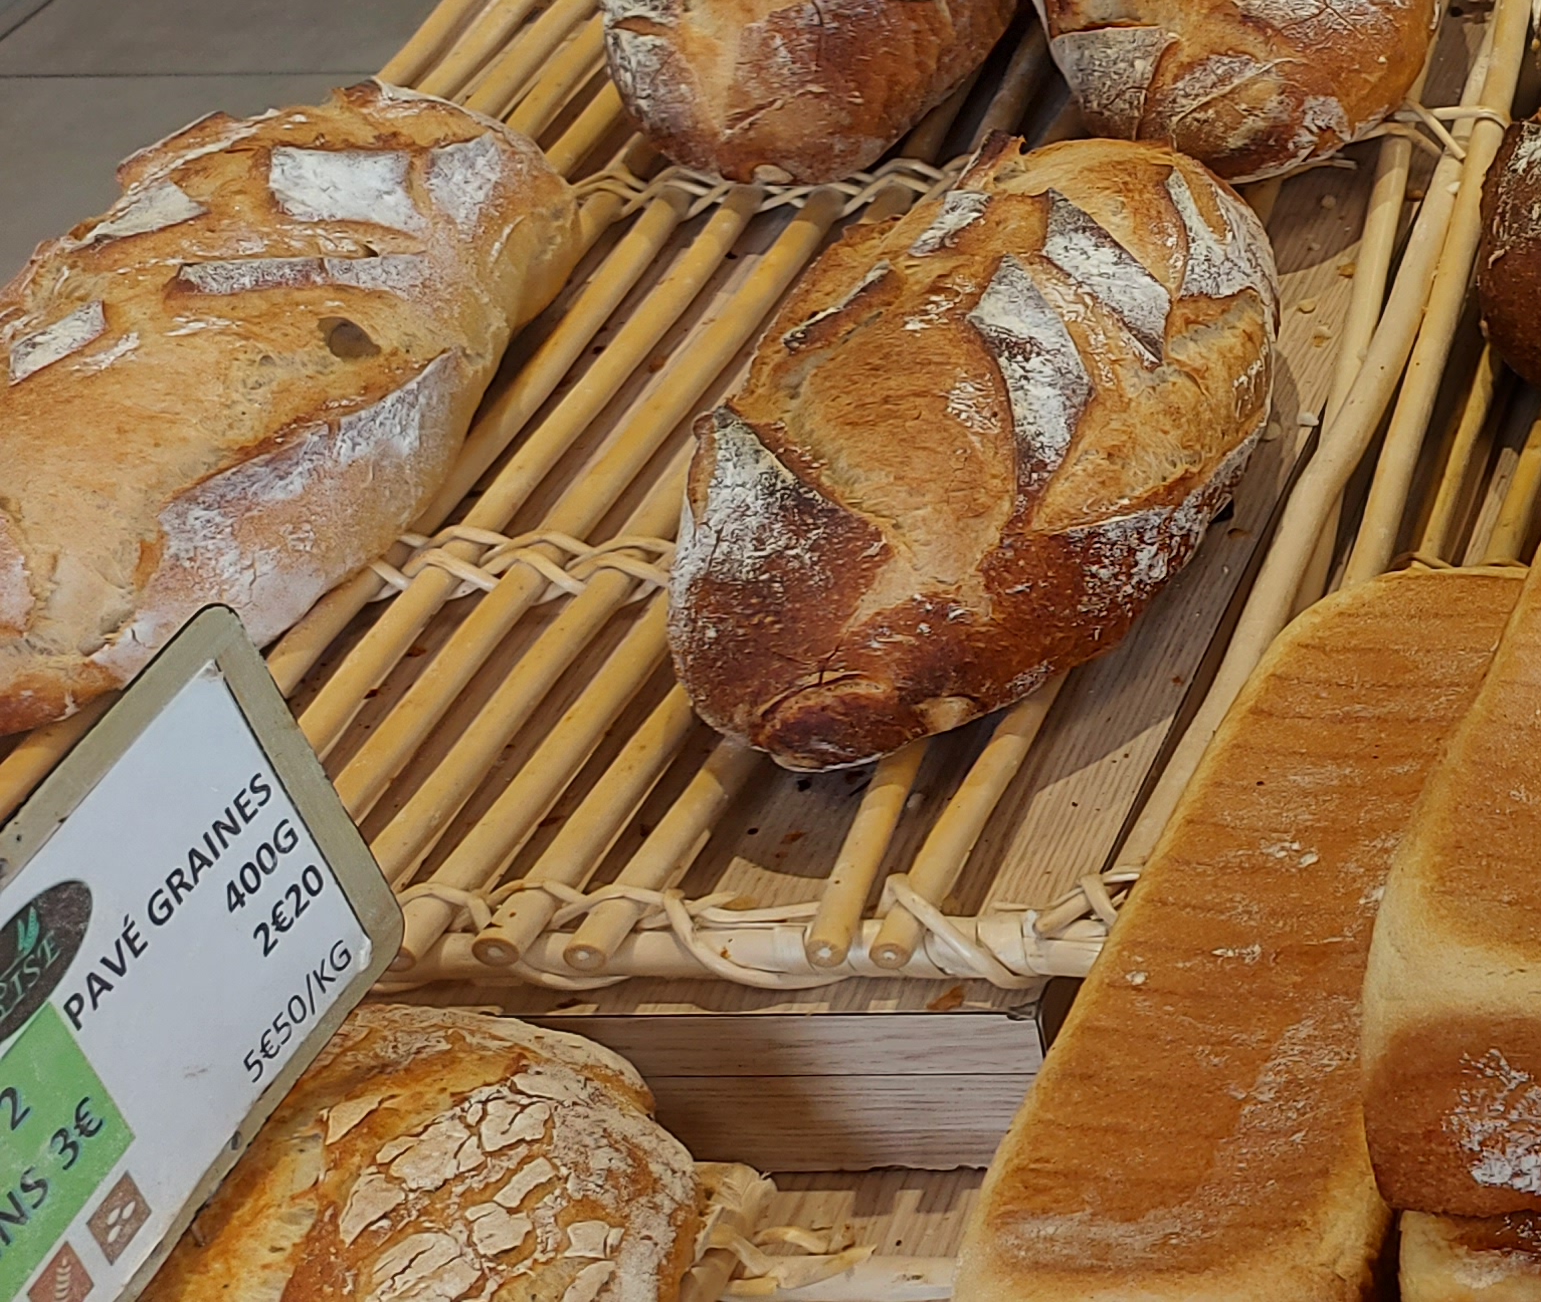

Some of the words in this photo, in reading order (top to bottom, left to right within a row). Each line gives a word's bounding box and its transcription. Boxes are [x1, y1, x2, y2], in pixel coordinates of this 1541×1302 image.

[63, 912, 150, 1032] PAVÉ
[147, 771, 274, 929] GRAINES
[225, 819, 301, 914] 400G
[252, 864, 326, 959] 2€20
[242, 939, 354, 1084] 5€50/KG
[50, 1096, 104, 1171] 3€
